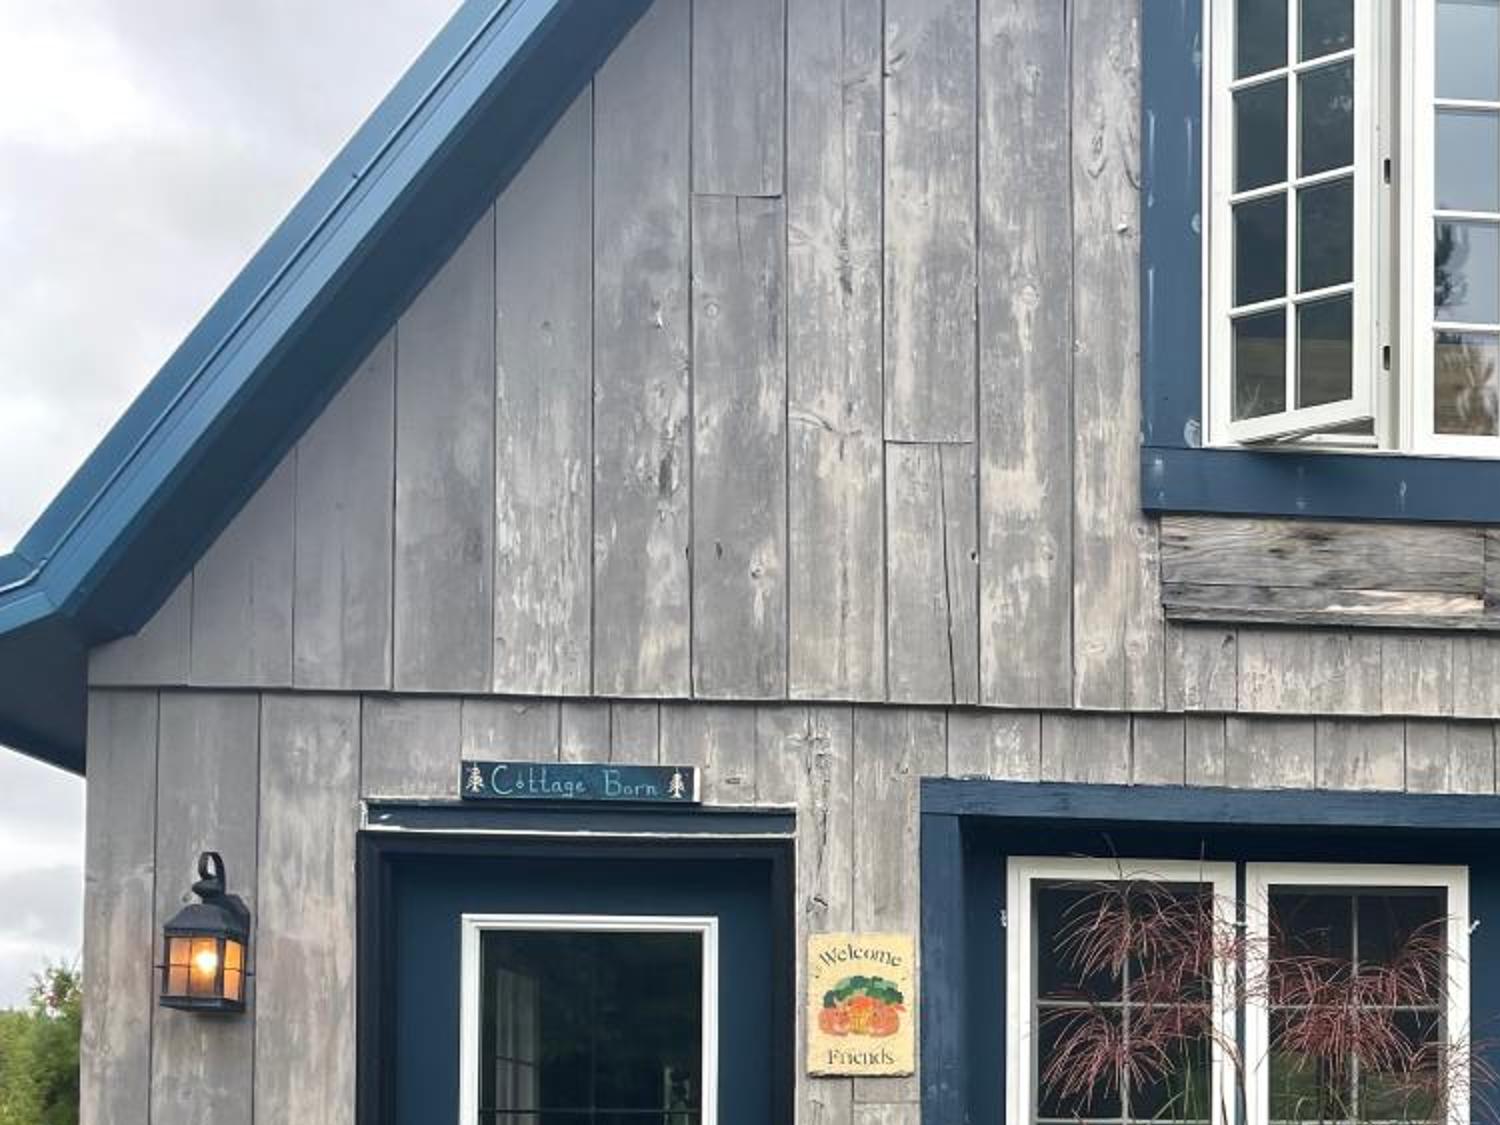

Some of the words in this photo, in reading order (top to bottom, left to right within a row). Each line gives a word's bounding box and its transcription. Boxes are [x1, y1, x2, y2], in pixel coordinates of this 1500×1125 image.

[491, 764, 586, 798] Cottage
[819, 943, 902, 967] Welcome
[828, 1047, 895, 1066] Friends
